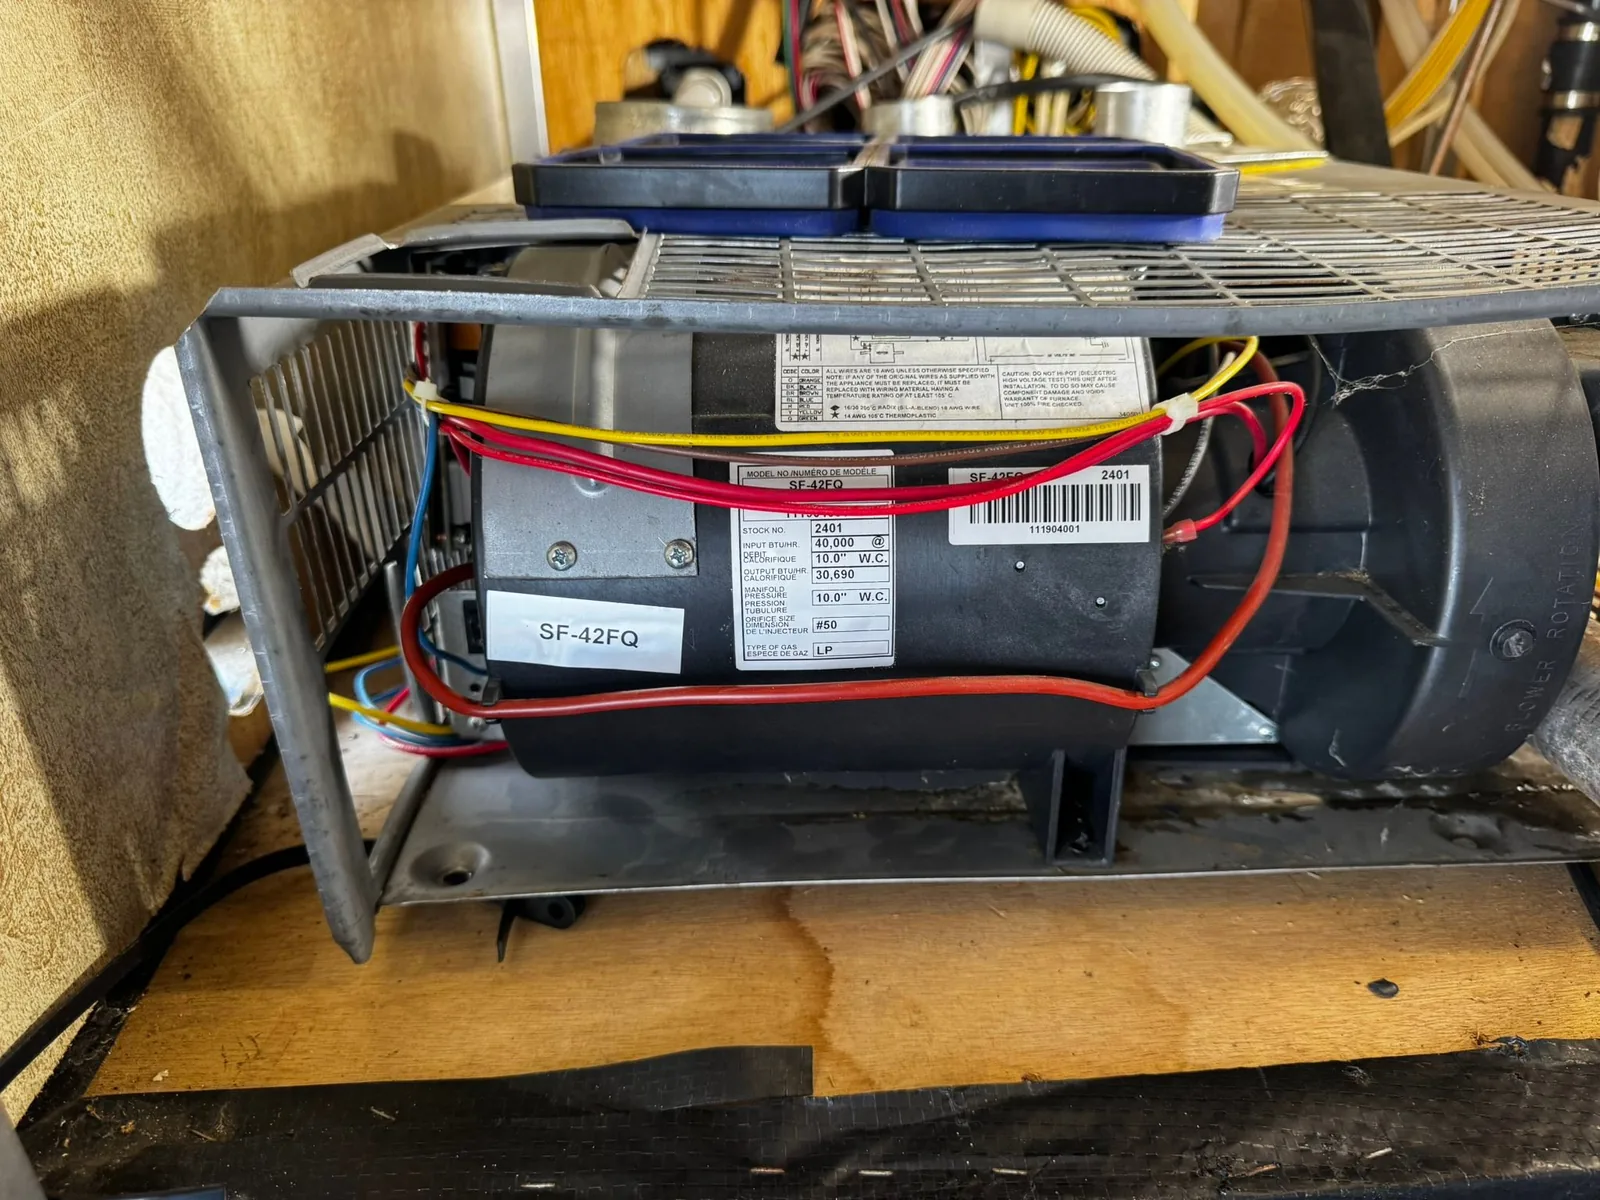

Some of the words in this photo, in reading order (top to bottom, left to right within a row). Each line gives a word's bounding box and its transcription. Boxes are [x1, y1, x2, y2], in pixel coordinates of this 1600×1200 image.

[1102, 470, 1130, 480] 2401
[789, 480, 843, 490] SF-42FQ
[815, 523, 842, 533] 2401
[1029, 525, 1080, 533] 111904001
[815, 538, 854, 549] 40,000
[871, 536, 885, 549] @
[859, 553, 888, 563] W.C.
[816, 570, 855, 580] 30,690
[859, 592, 888, 602] W.C.
[816, 621, 837, 629] #50
[1504, 660, 1556, 734] BLOWER
[1546, 525, 1581, 639] ROTATION
[539, 623, 639, 648] SF-42FQ
[816, 646, 833, 654] LP
